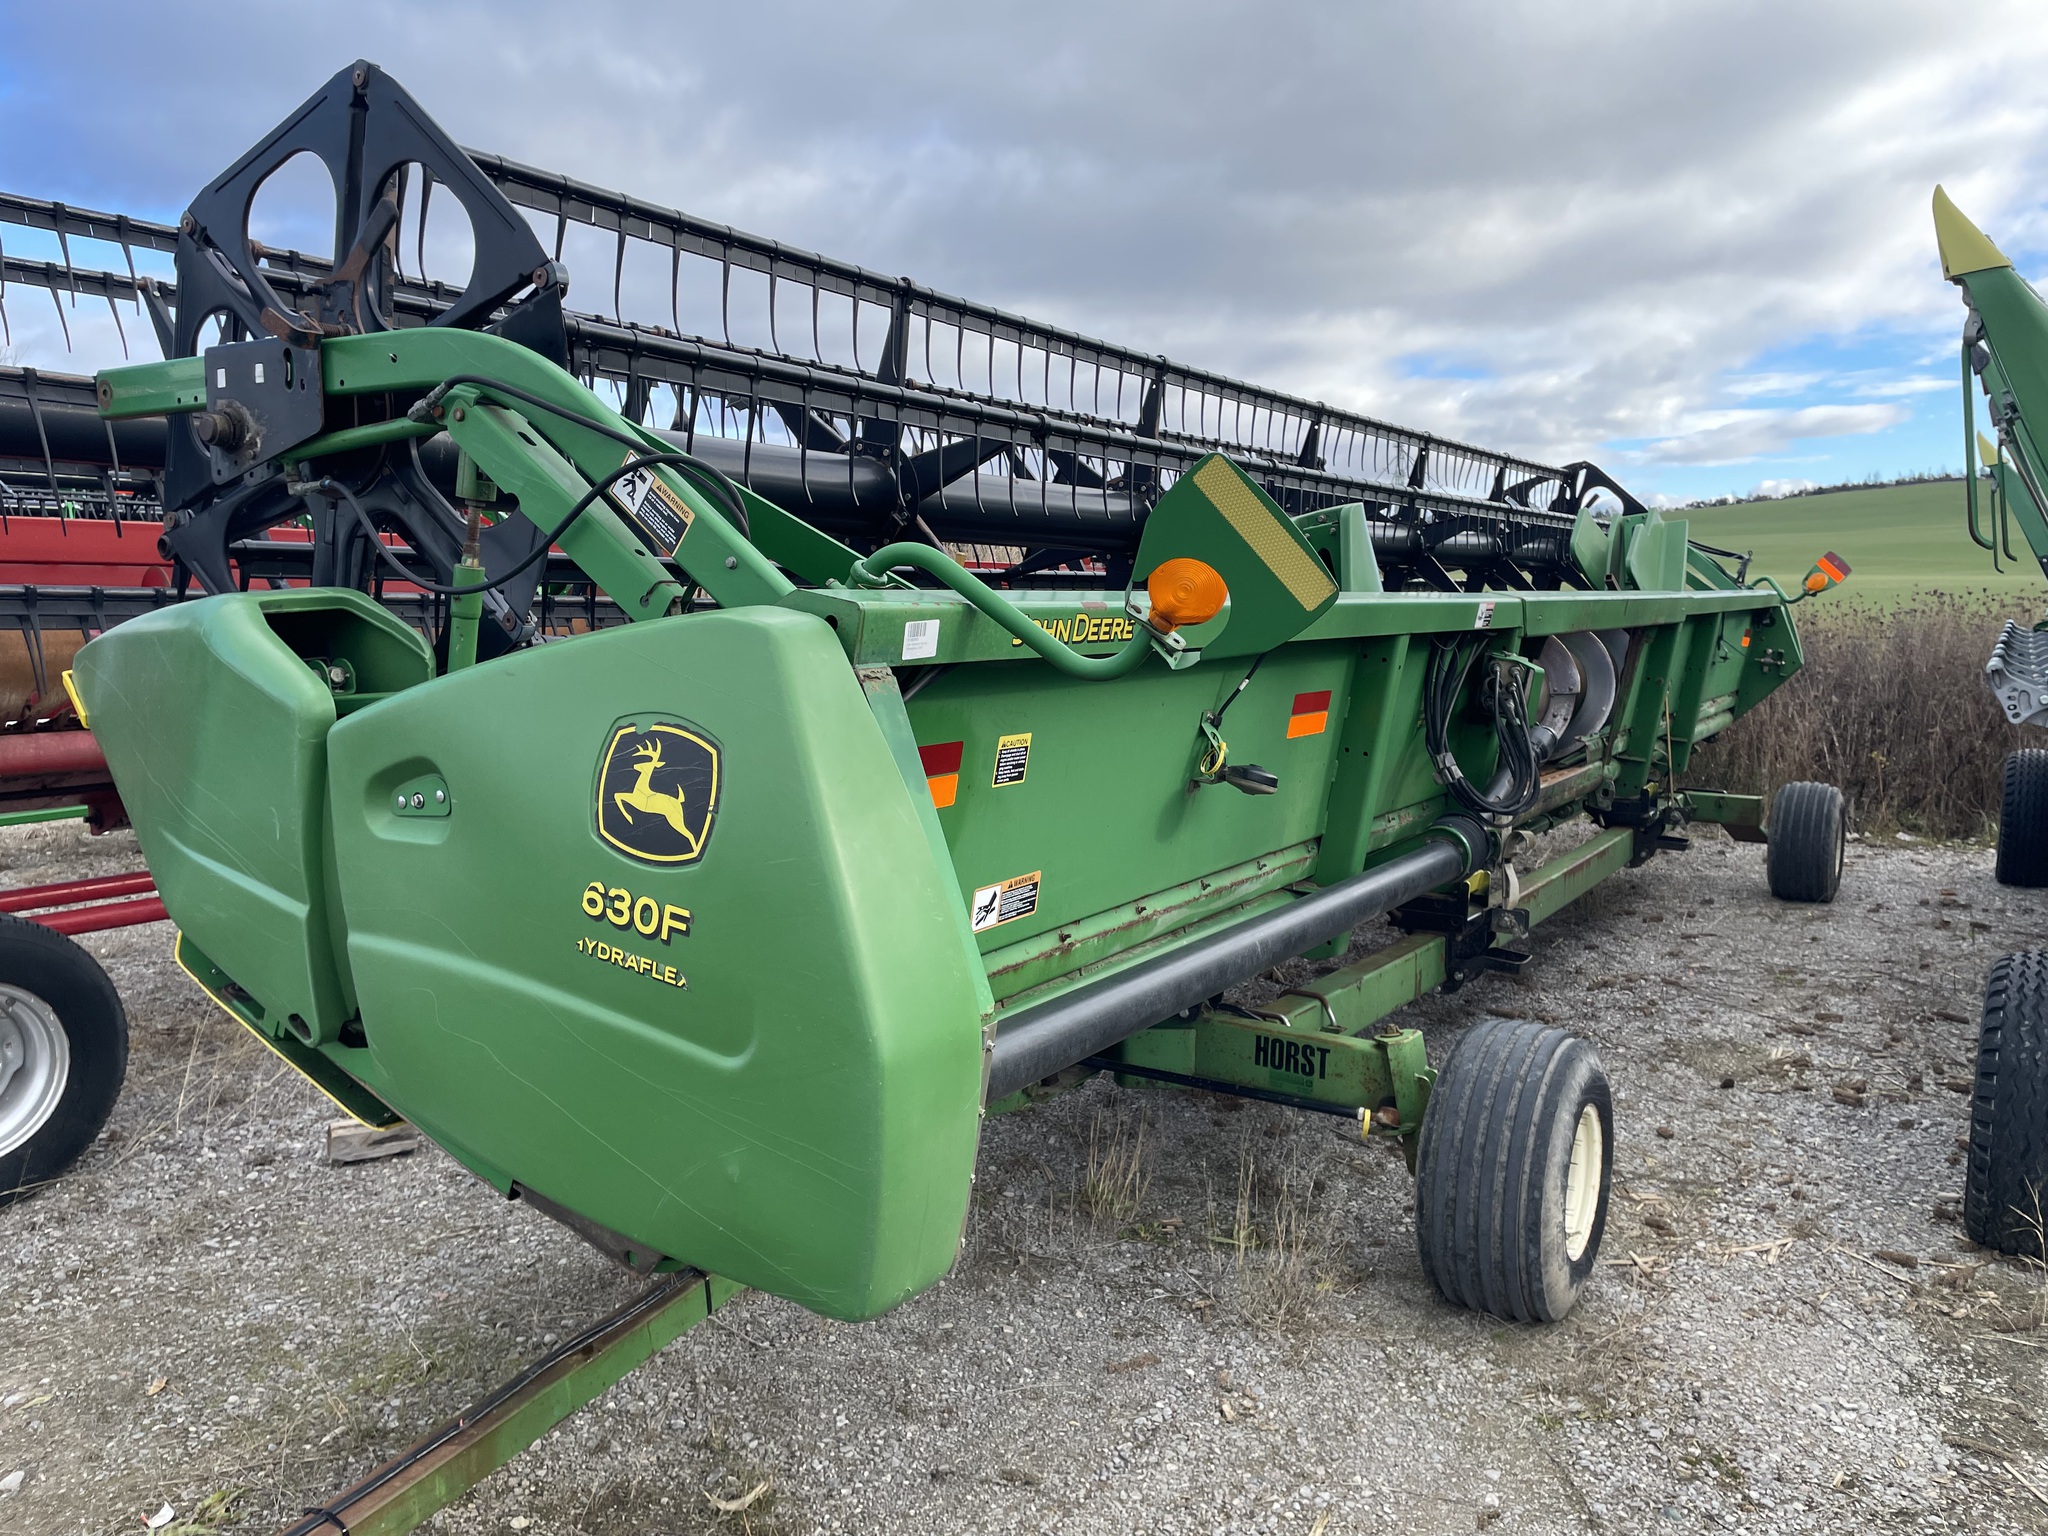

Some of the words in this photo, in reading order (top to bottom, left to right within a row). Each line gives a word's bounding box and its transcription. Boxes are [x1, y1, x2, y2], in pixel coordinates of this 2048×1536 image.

[661, 488, 690, 519] WARNING
[1072, 613, 1136, 643] DEERE
[582, 881, 693, 944] 630F
[1255, 1034, 1331, 1080] HORST
